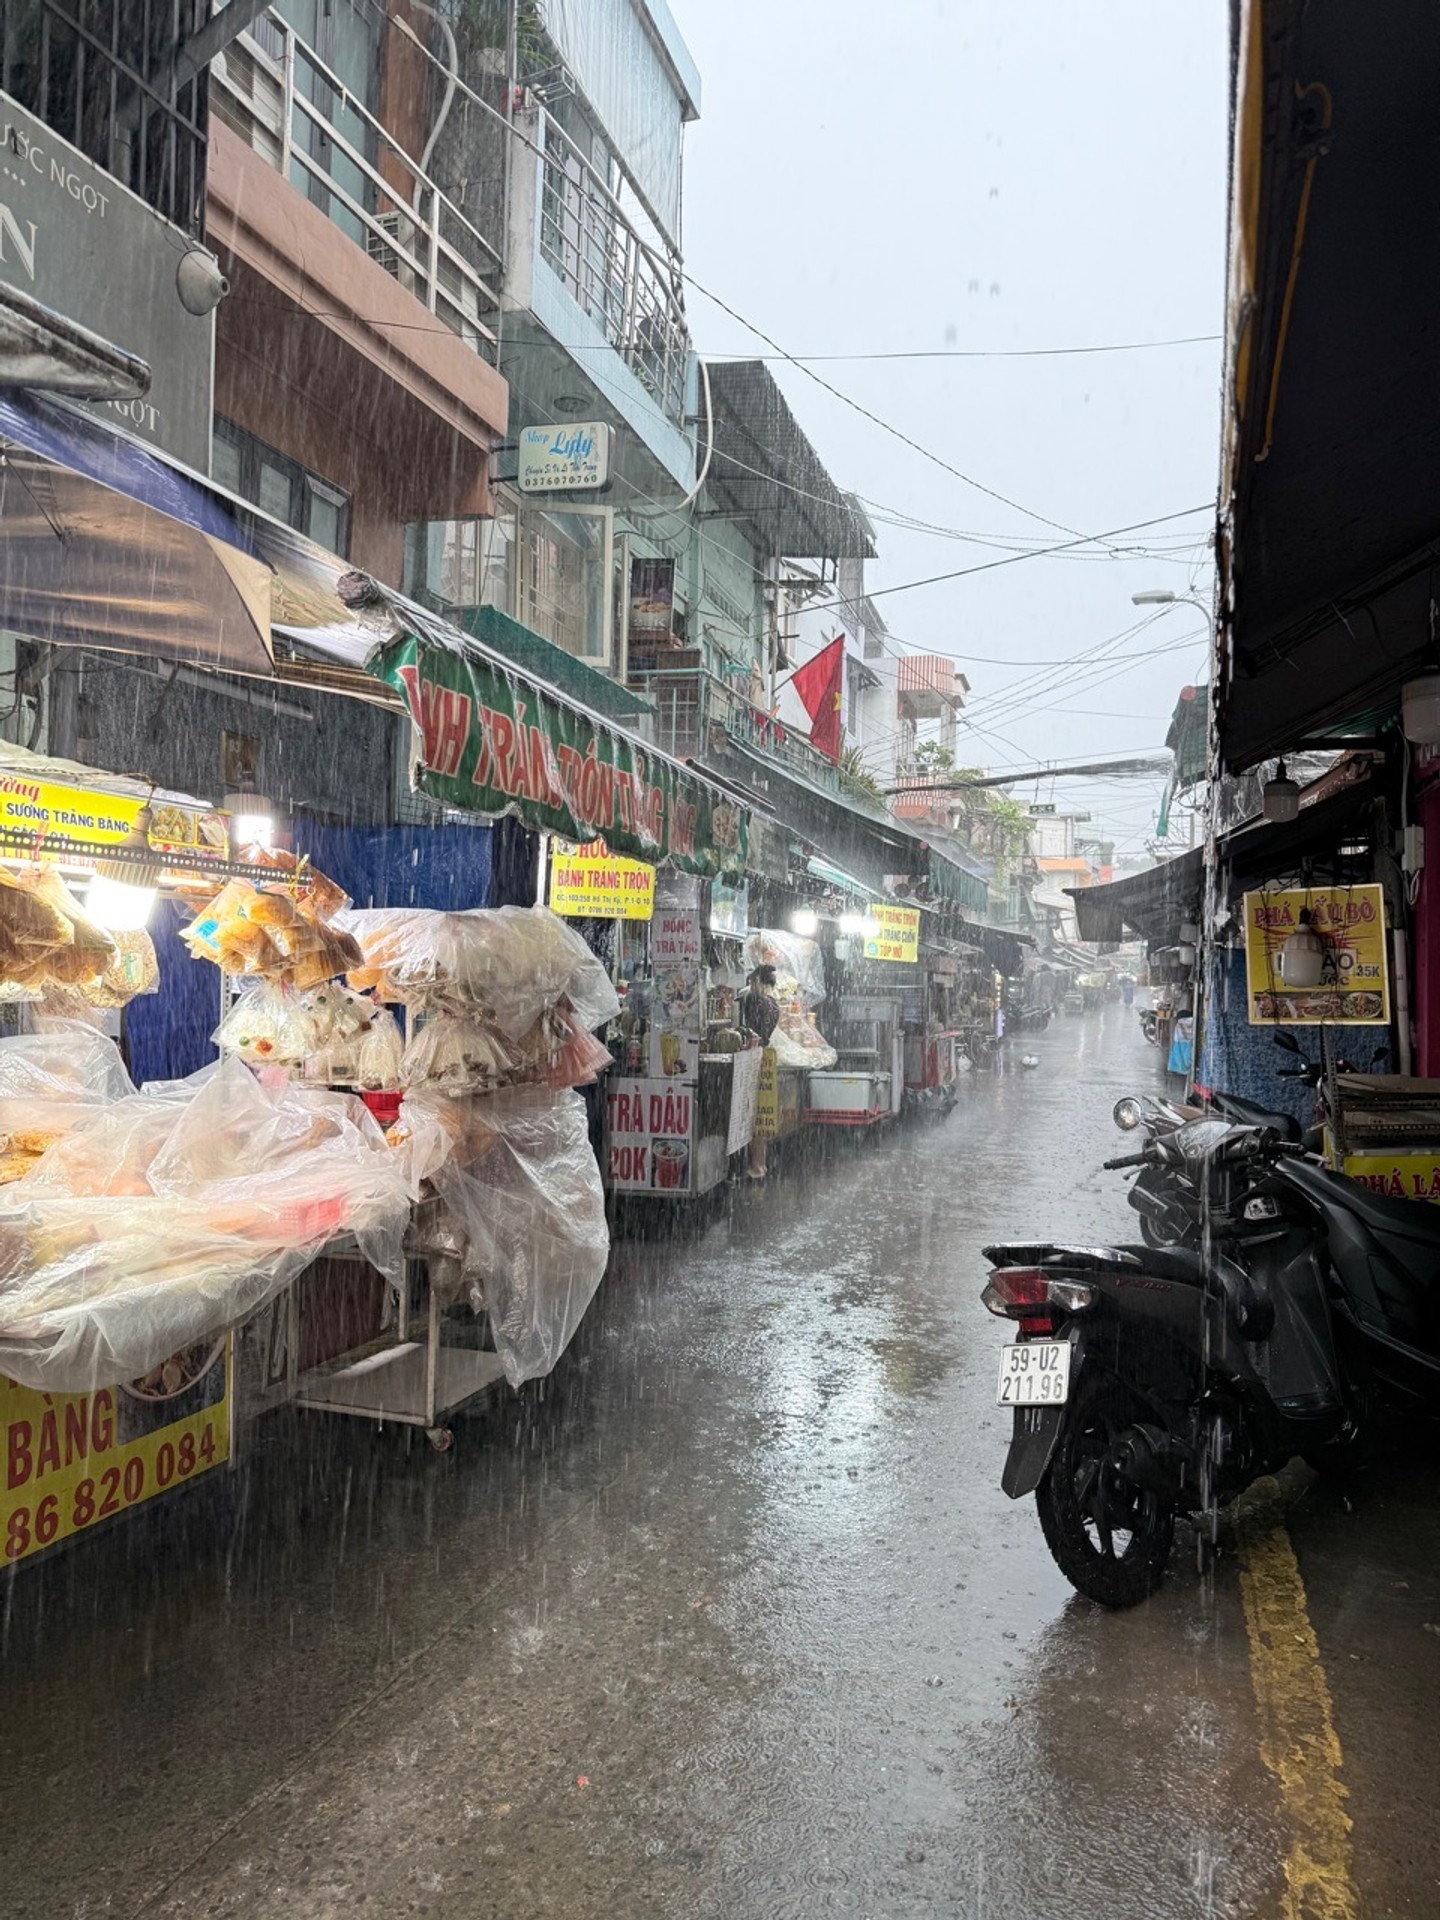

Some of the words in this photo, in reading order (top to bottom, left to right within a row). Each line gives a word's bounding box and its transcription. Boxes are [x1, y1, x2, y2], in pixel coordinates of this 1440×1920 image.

[50, 157, 110, 218] NGỌT
[588, 866, 620, 888] TRÁNG
[1253, 901, 1295, 926] PHÁ
[1347, 896, 1376, 923] BÒ
[1356, 965, 1380, 978] 35K
[607, 1085, 644, 1133] TRÀ
[649, 1086, 690, 1135] DÂU
[607, 1146, 648, 1181] 20K
[1011, 1346, 1059, 1372] 59-U2
[1002, 1374, 1063, 1401] 211.96
[7, 1389, 114, 1491] BÀNG
[72, 1456, 145, 1527] 820
[156, 1422, 216, 1487] 084
